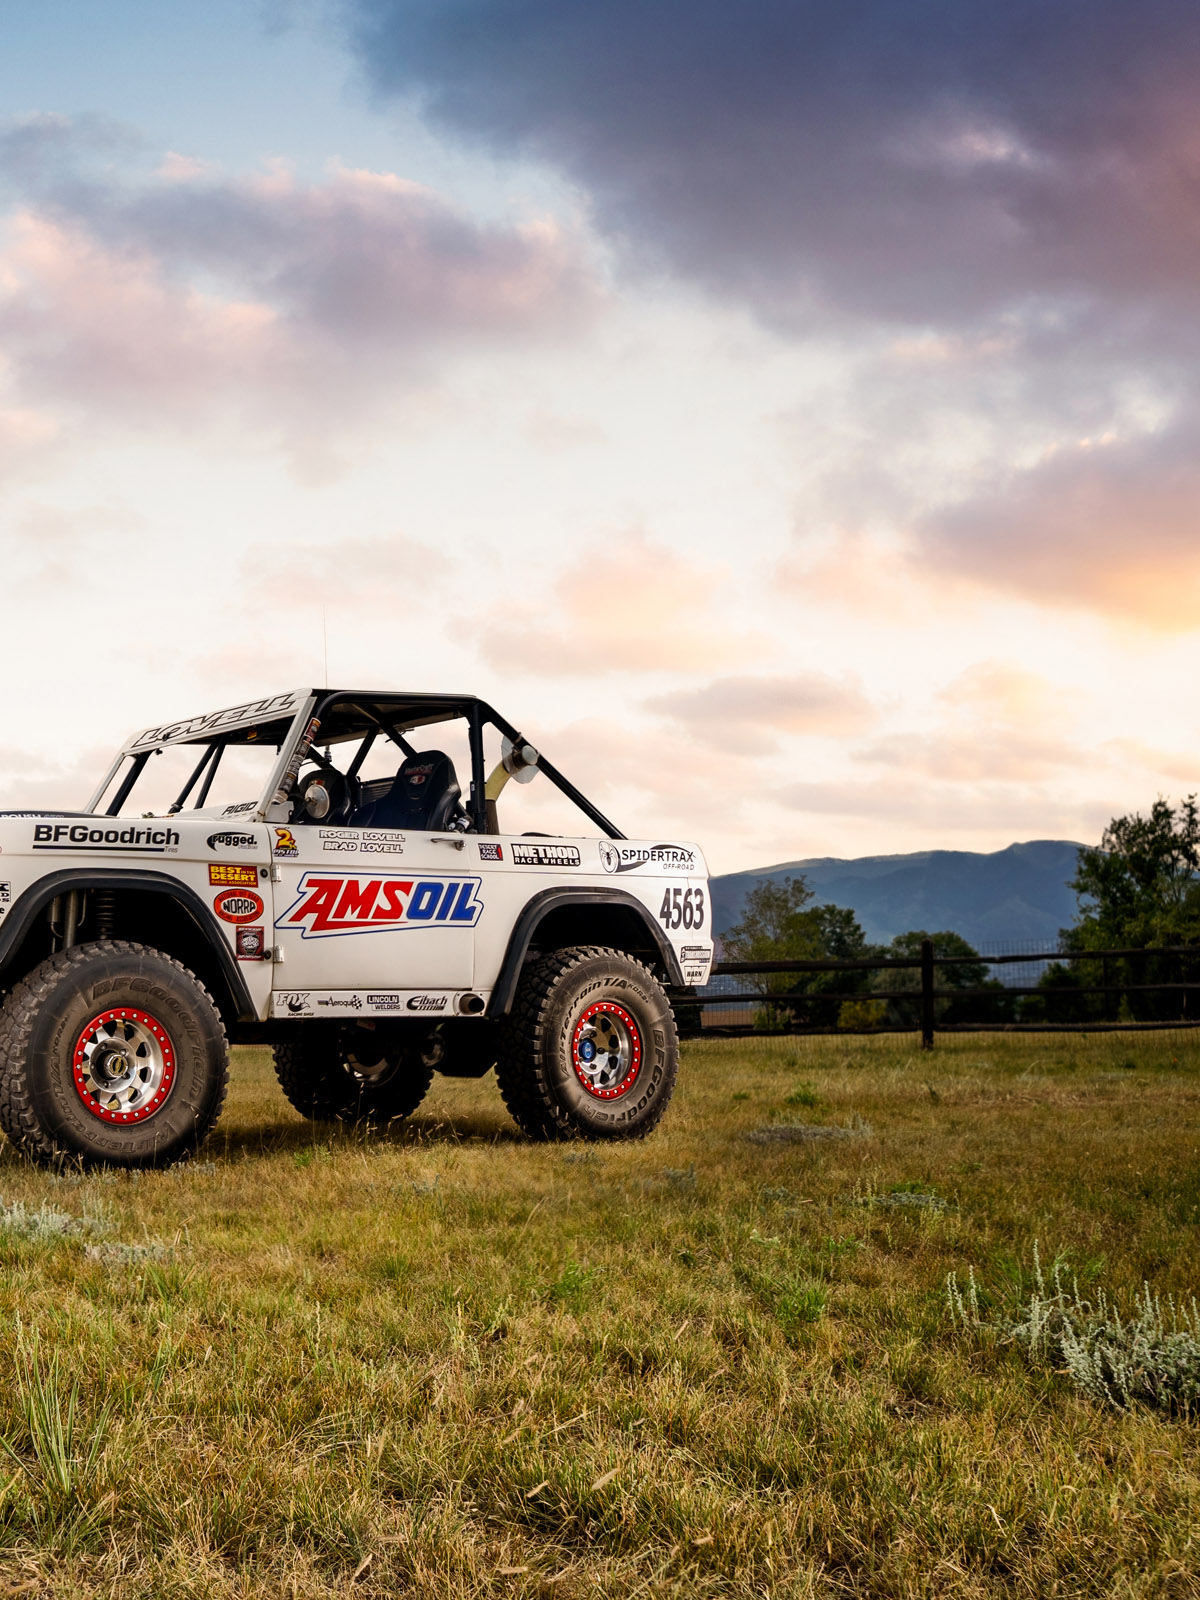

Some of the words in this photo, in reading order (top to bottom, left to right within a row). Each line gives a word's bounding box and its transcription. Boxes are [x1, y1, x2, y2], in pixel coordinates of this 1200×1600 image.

[131, 693, 296, 749] LOVELL
[222, 801, 259, 816] RIGID
[33, 824, 180, 845] BFGoodrich
[319, 830, 359, 840] ROGER
[363, 832, 405, 842] LOVELL
[323, 841, 357, 851] BRAD
[360, 843, 403, 854] LOVELL
[512, 845, 579, 859] METHOD
[542, 858, 580, 866] WHEELS
[622, 849, 694, 863] SPIDERTRAX
[210, 866, 242, 874] BEST
[663, 863, 695, 871] OFF-ROAD
[211, 873, 256, 881] DESERT
[222, 898, 256, 914] NORRA
[288, 878, 477, 932] AMSOIL
[659, 888, 704, 930] 4563
[276, 993, 310, 1007] FOX
[368, 995, 399, 1004] LINCOLN
[406, 994, 448, 1010] Eibach
[559, 981, 601, 1077] All-Terrain
[604, 977, 628, 990] T/A
